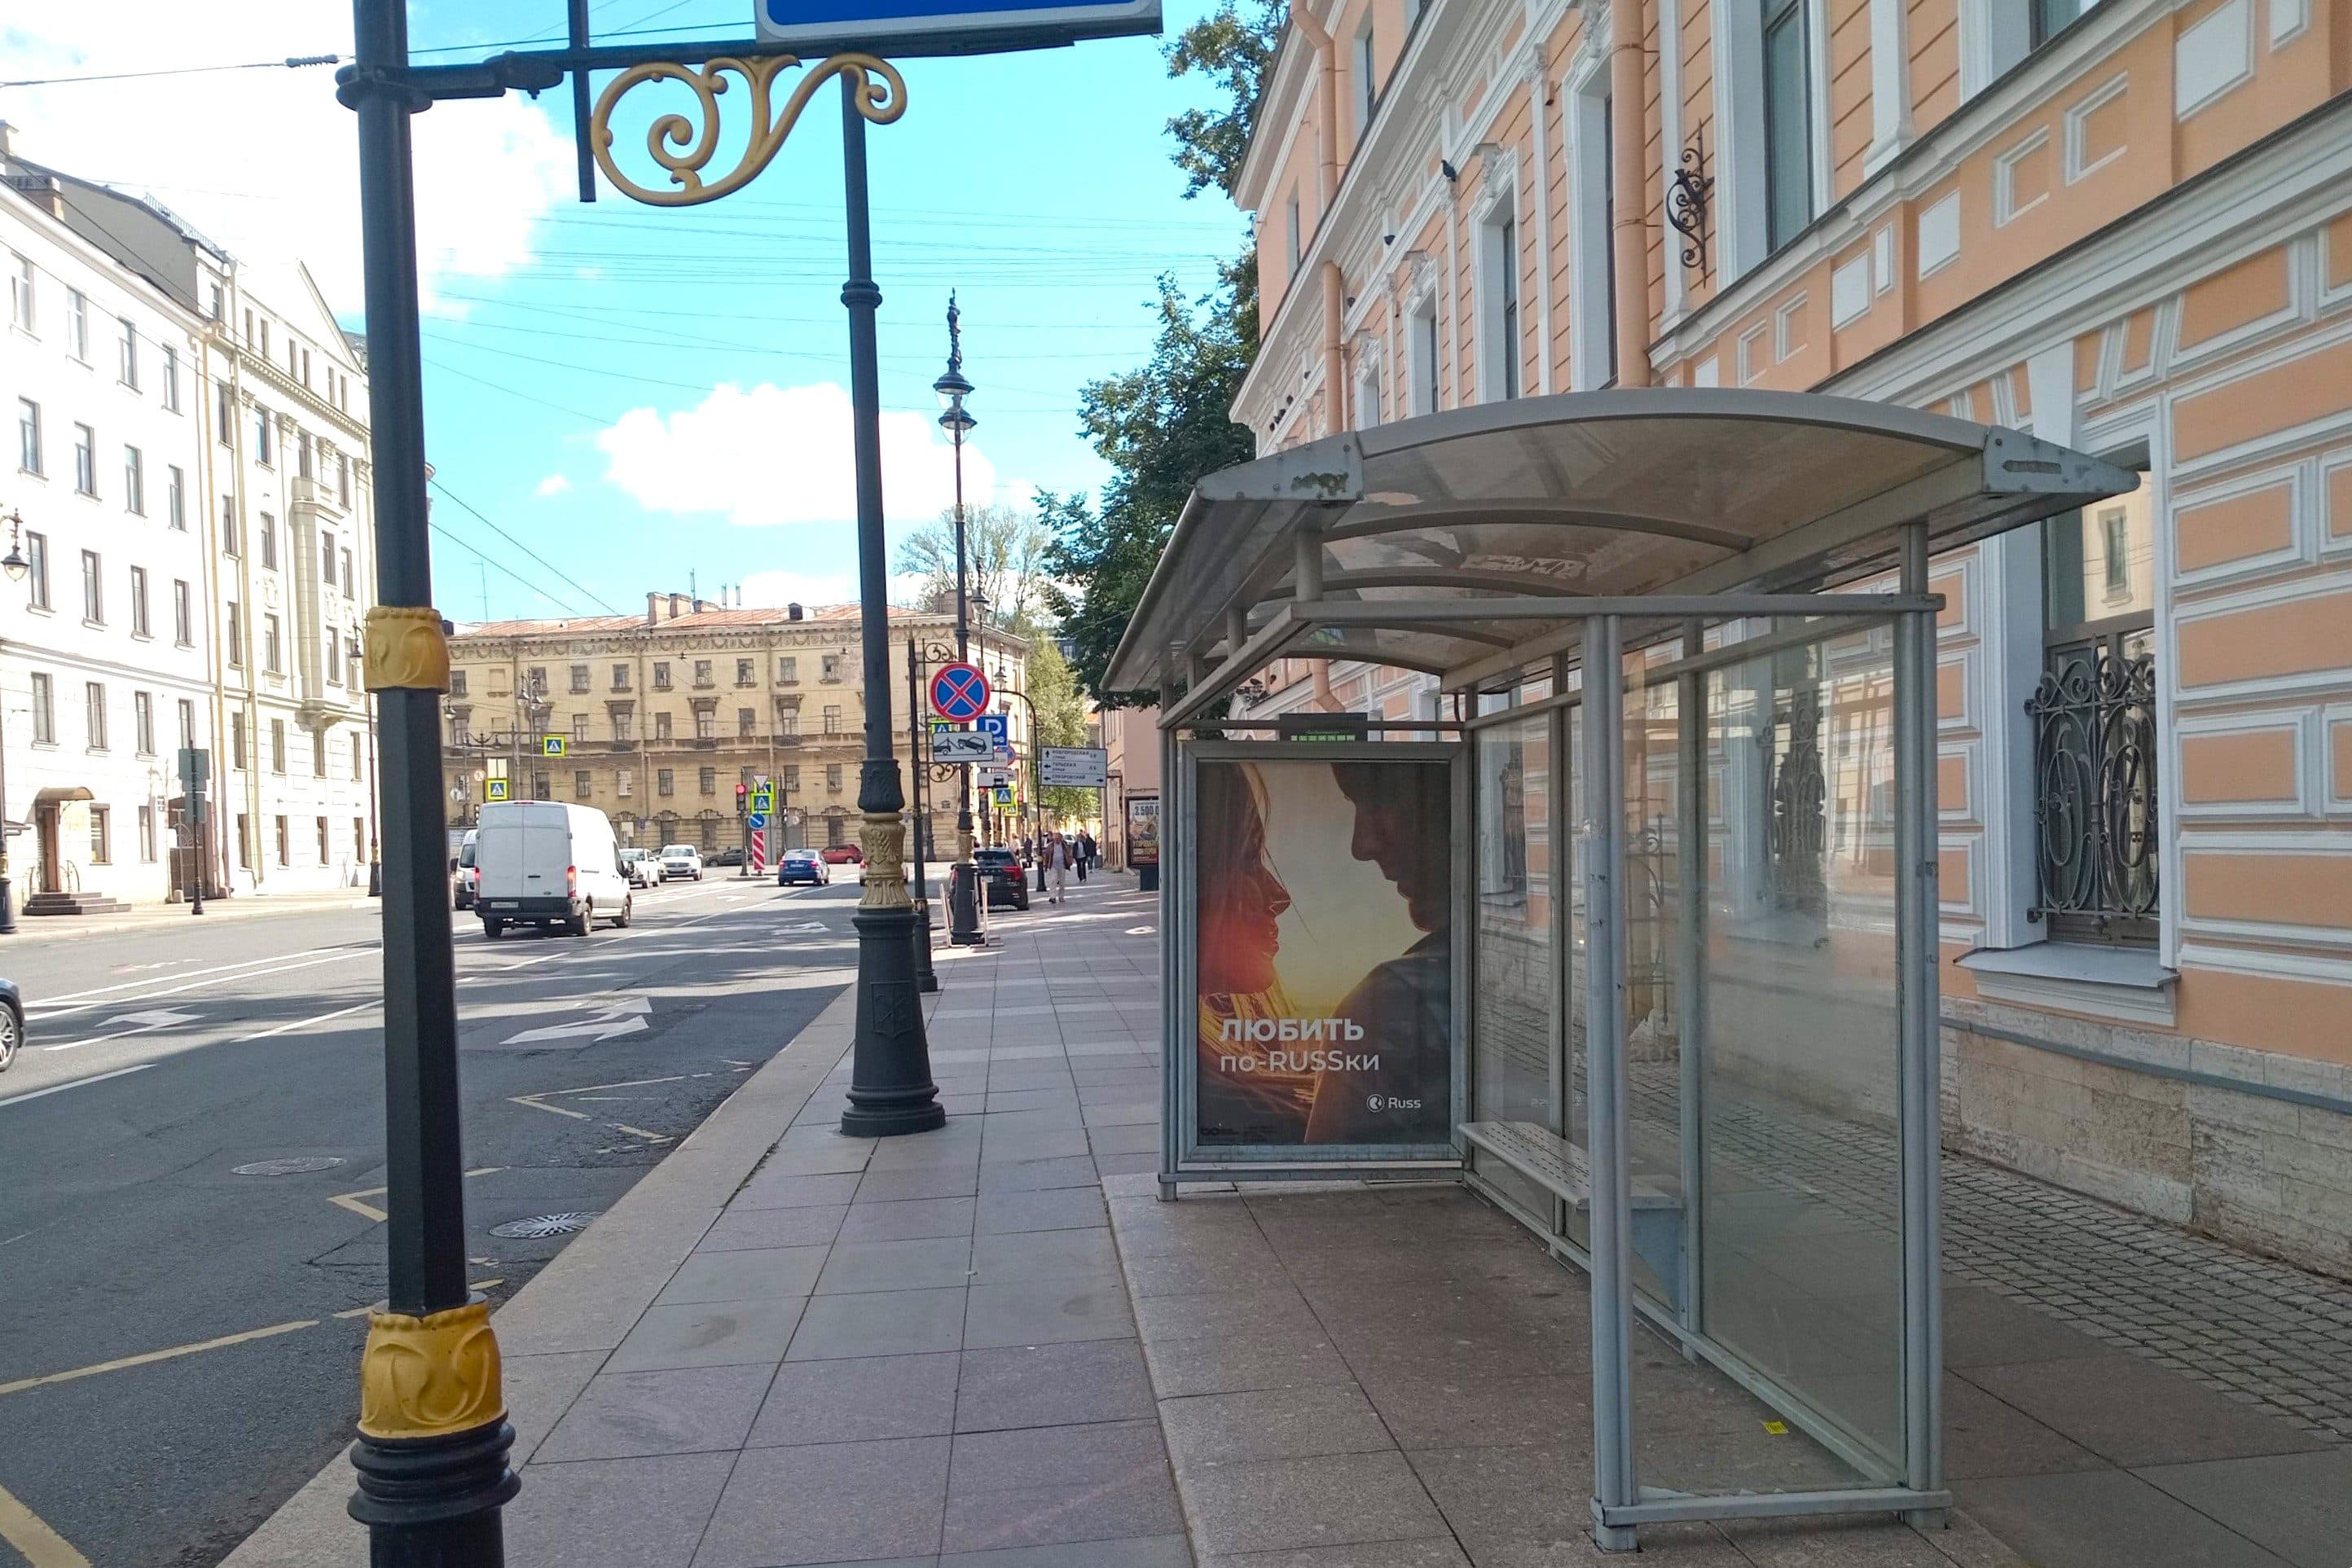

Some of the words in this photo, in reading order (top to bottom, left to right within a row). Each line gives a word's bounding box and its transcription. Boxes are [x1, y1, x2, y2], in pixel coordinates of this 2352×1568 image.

[1219, 1018, 1365, 1042] ЛЮБИТЬ
[1220, 1050, 1380, 1073] по-RUSSки
[1387, 1097, 1422, 1109] Russ
